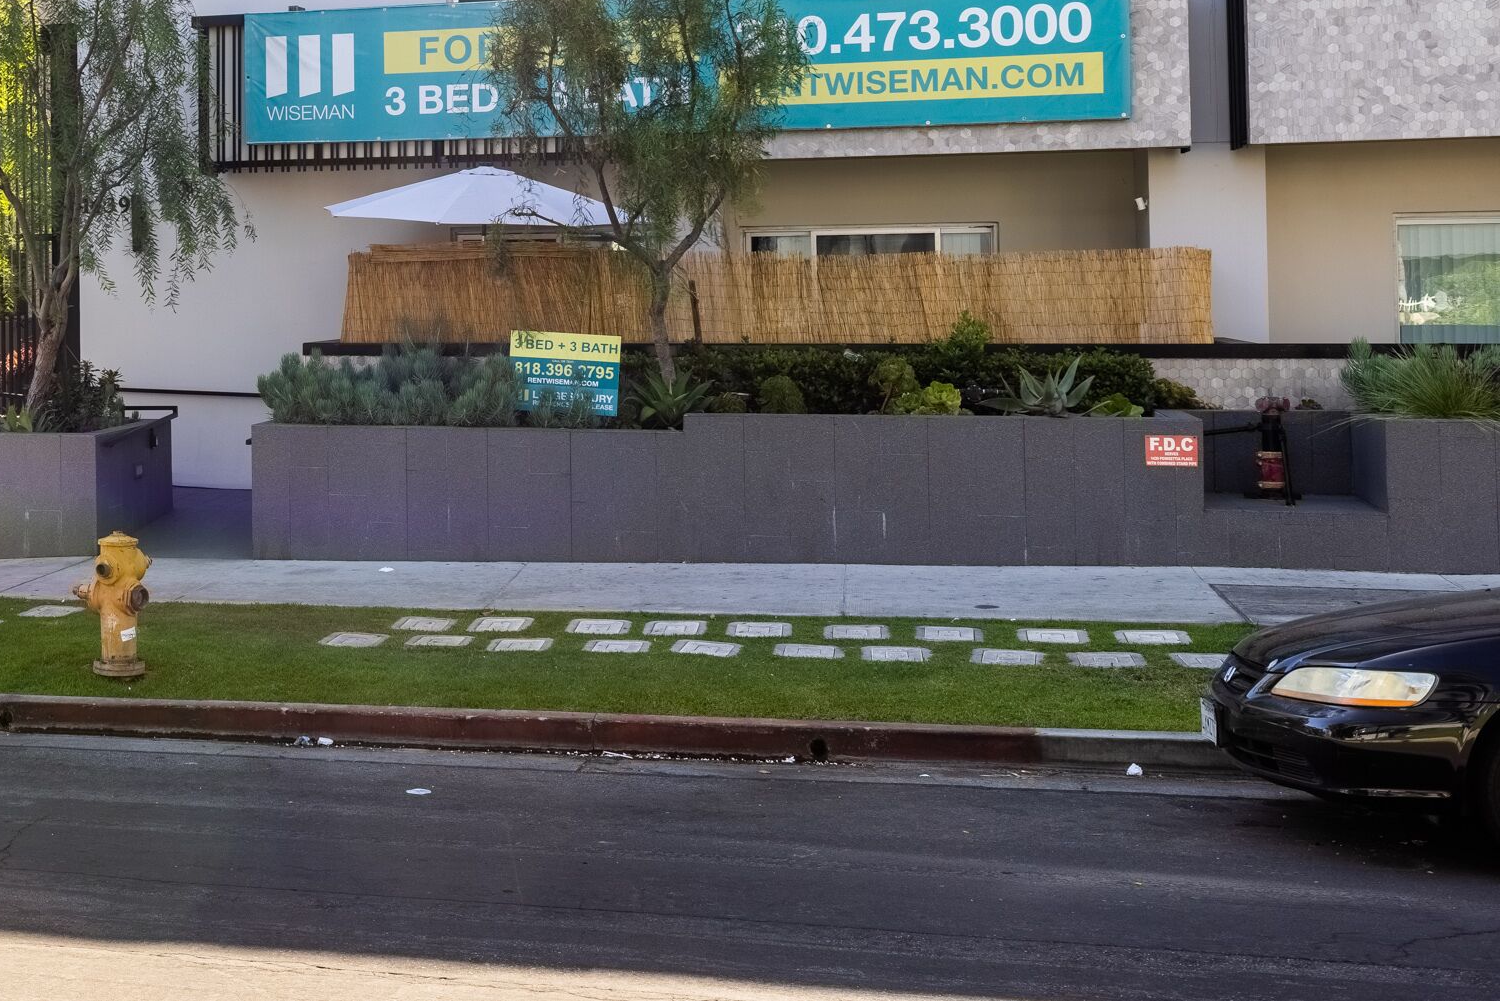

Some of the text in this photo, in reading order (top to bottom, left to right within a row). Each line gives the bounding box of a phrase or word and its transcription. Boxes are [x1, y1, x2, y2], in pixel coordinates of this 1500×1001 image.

[740, 62, 1085, 98] TWISEMAN.COM
[384, 86, 407, 116] 3
[419, 83, 500, 115] BED
[266, 103, 355, 121] WISEMAN
[526, 340, 554, 350] BED
[558, 342, 566, 350] +
[570, 341, 577, 351] 3
[581, 343, 618, 354] BATH
[1149, 437, 1194, 452] F.D.C
